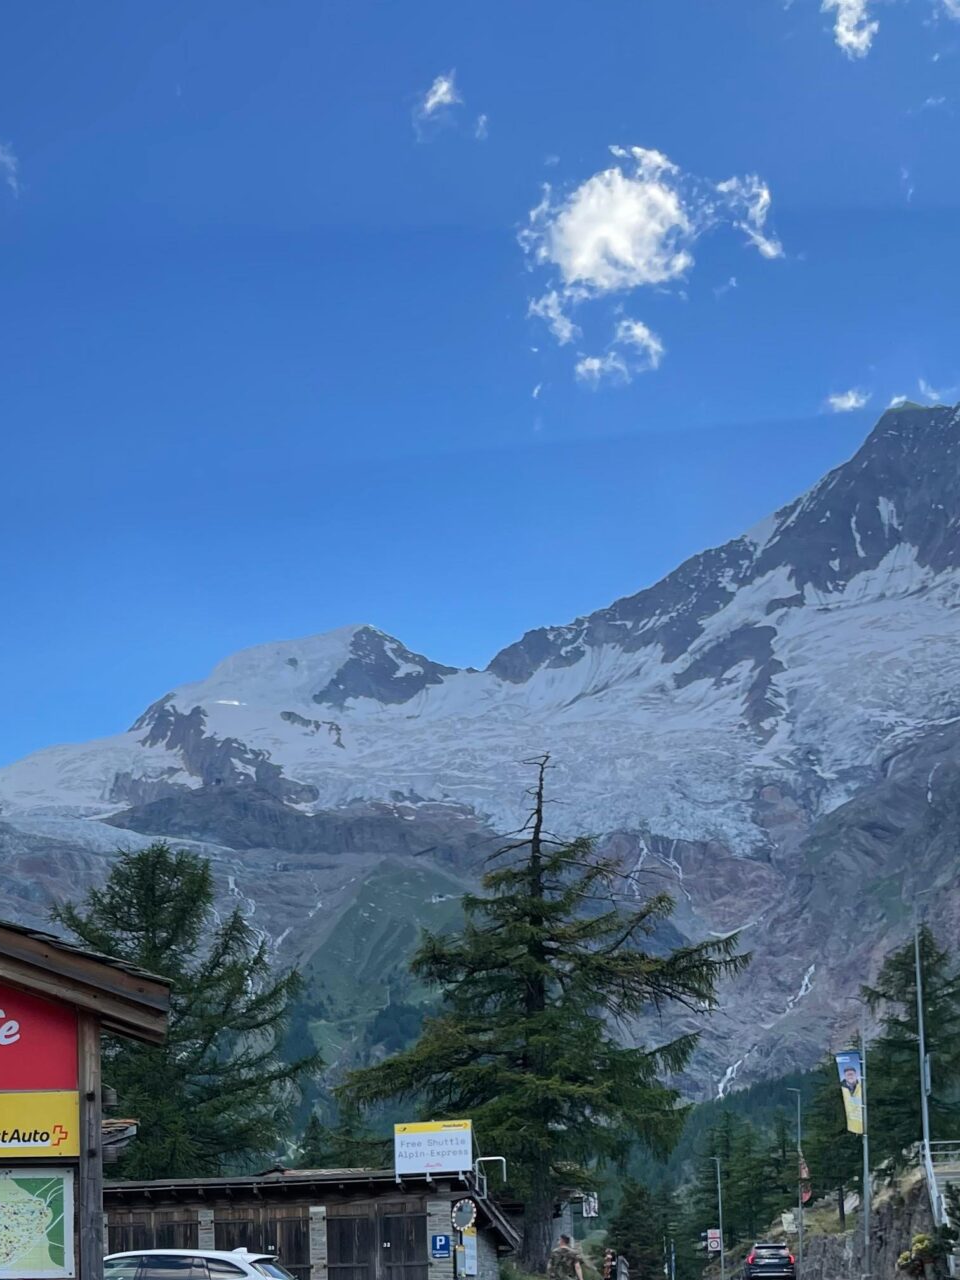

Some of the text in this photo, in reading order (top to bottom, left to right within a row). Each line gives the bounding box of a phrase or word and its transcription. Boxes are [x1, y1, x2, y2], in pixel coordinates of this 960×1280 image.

[400, 1138, 466, 1148] Free Shuttle
[398, 1149, 469, 1160] Alpin Express
[436, 1236, 445, 1250] P
